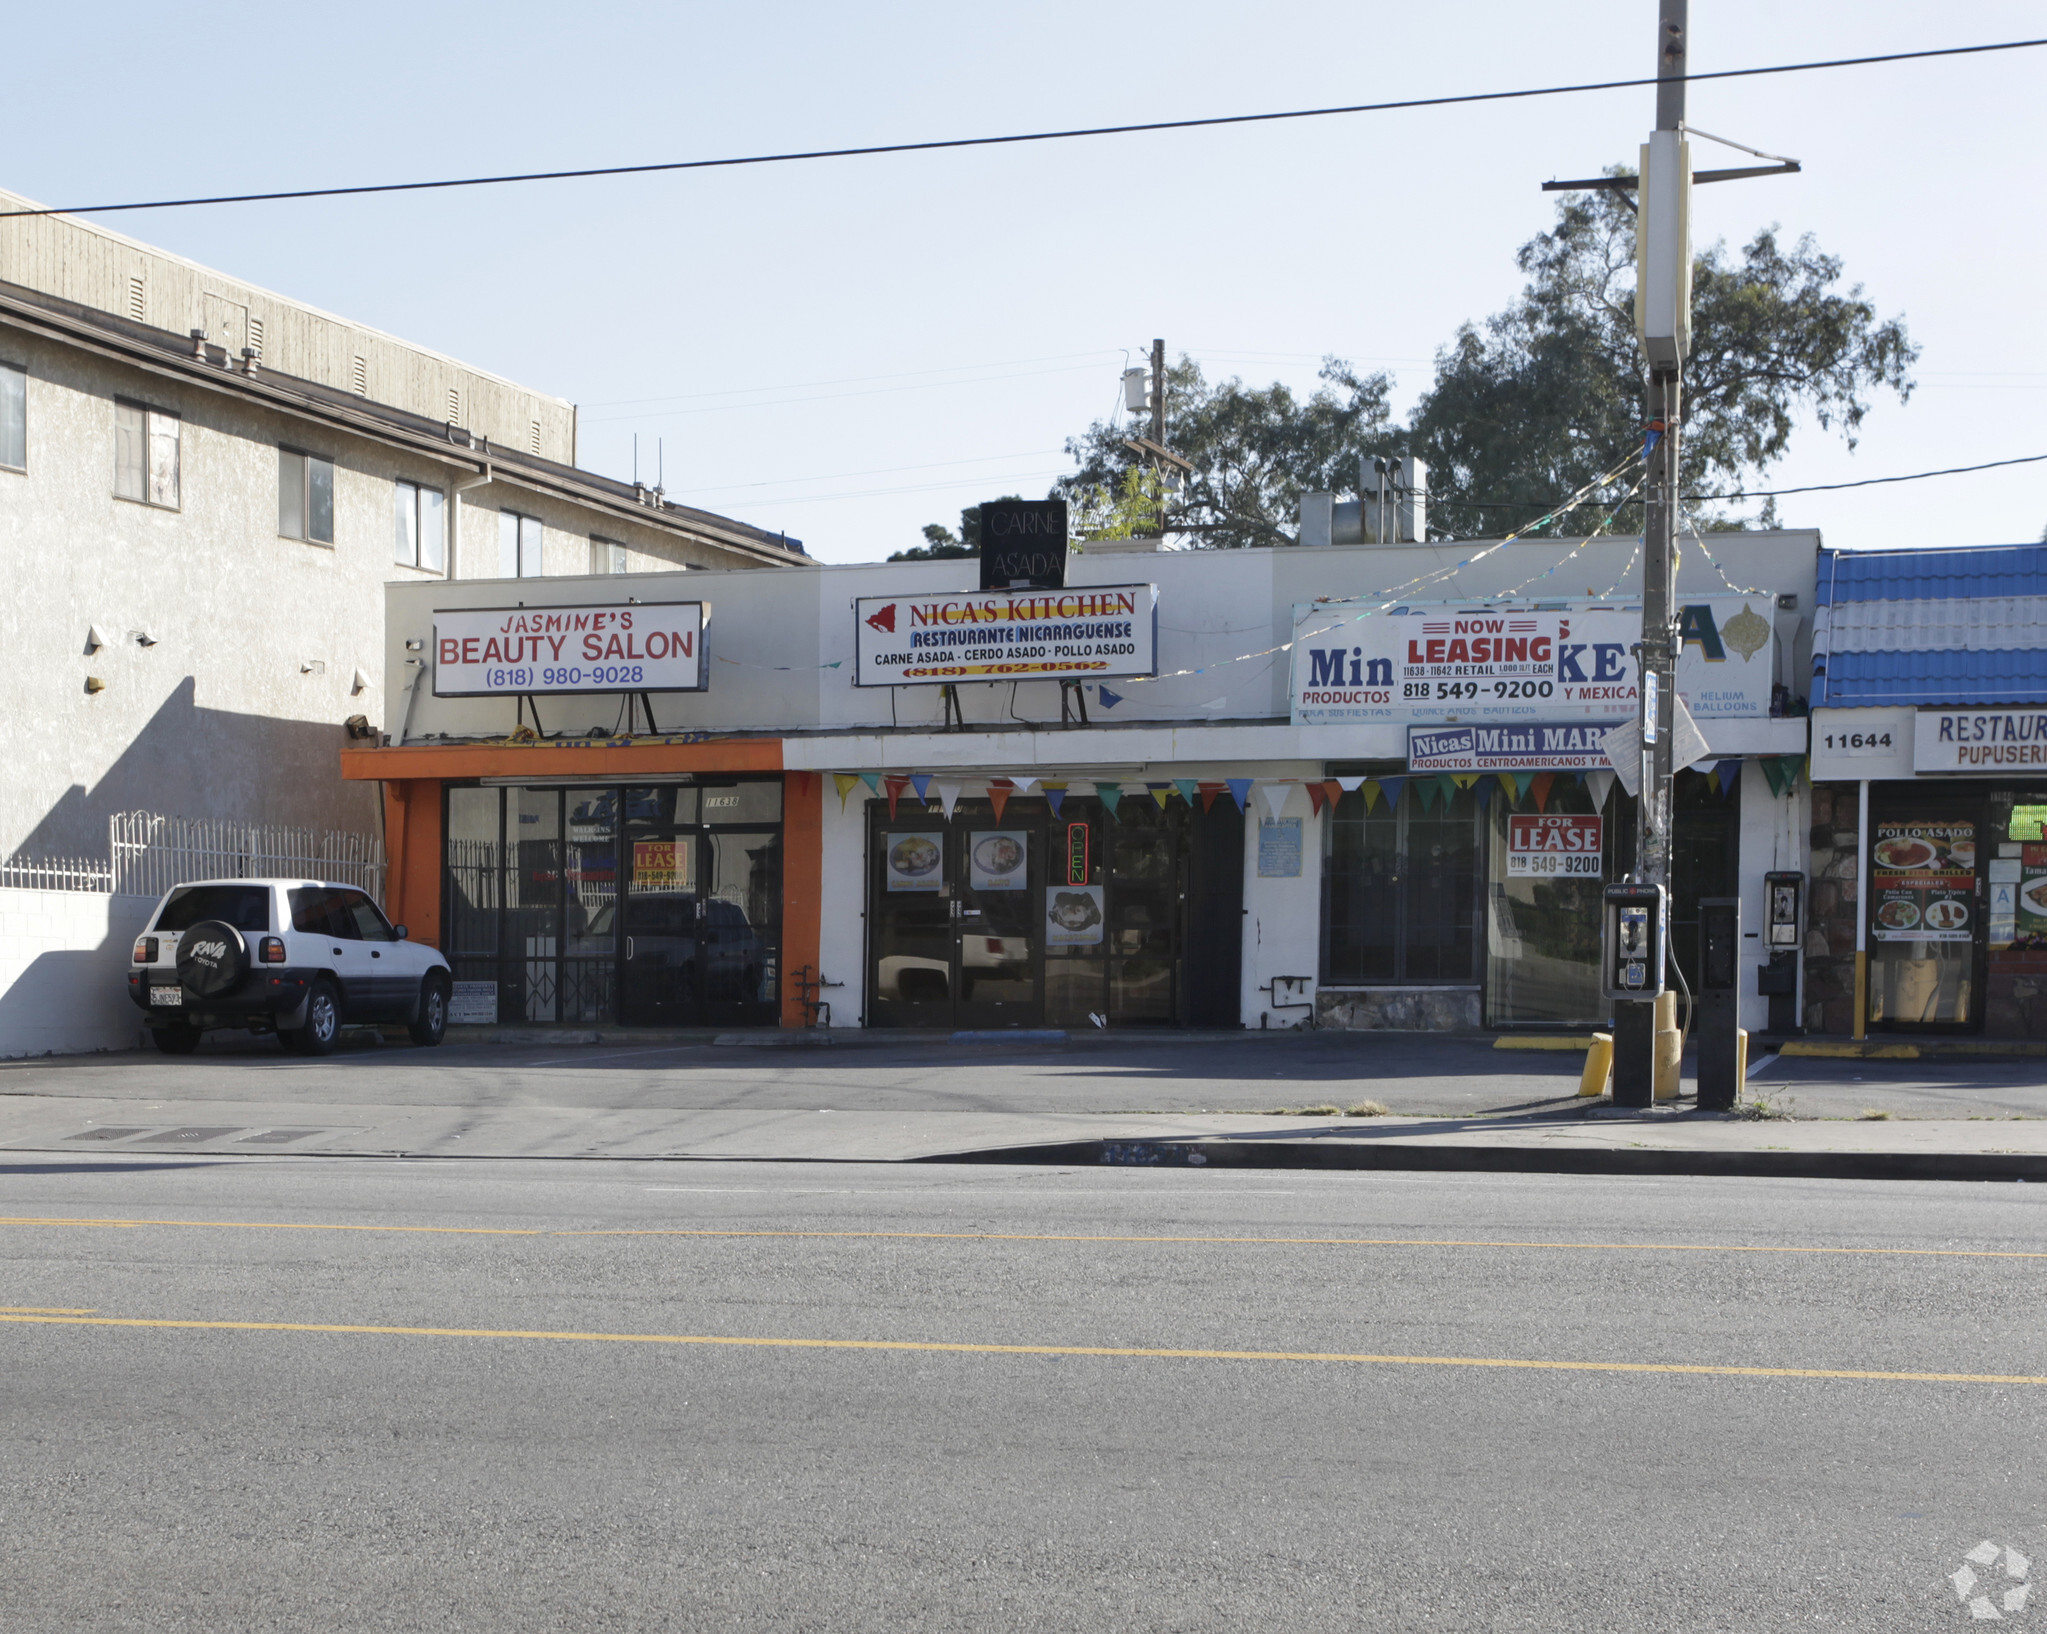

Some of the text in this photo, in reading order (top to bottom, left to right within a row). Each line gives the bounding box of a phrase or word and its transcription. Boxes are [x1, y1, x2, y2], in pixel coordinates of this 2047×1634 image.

[990, 511, 1061, 536] CARNE
[992, 552, 1062, 577] ASADA
[909, 592, 1136, 627] NICA'S KITCHEN
[500, 611, 633, 634] JASMINE'S
[1454, 620, 1504, 635] NOW
[910, 621, 1132, 649] RESTAURANTE NICARAGUENSE
[440, 631, 693, 665] BEAUTY SALON
[875, 643, 1135, 666] CARNE ASADA CERDO ASADO POLLO ASADO
[1408, 637, 1551, 664] LEASING
[486, 665, 643, 688] (818) 980-9028
[903, 661, 1107, 678] (818) 762-0562
[1308, 647, 1398, 687] Min
[1455, 664, 1494, 675] RETAIL
[1532, 664, 1554, 674] EACH
[1302, 691, 1390, 704] PRODUCTOS
[1403, 680, 1553, 700] 818 549-9200
[1564, 686, 1640, 700] Y MEXICA
[1700, 690, 1744, 702] HELIUM
[1694, 702, 1758, 712] BALLOONS
[1939, 714, 2047, 742] RESTAUR
[1414, 734, 1471, 756] Nicas
[1477, 728, 1536, 752] Mini
[1543, 726, 1617, 751] MAR
[1825, 733, 1892, 749] 11644
[1412, 758, 1472, 769] PRODUCTOS
[1477, 756, 1586, 768] CENTROAMERICANOS
[1591, 756, 1597, 766] Y
[1958, 744, 2047, 765] PUPUSERI
[708, 798, 738, 807] 11638
[1538, 817, 1574, 828] FOR
[572, 834, 610, 843] WELCOME
[1514, 828, 1597, 851] LEASE
[1877, 828, 1973, 838] POLLO ASADO
[636, 853, 684, 867] LEASE
[1071, 826, 1085, 882] OPEN
[1511, 856, 1599, 873] 818 549-9200
[1997, 888, 2009, 903] A
[190, 940, 226, 959] RAV4
[194, 956, 218, 969] TOYOTA
